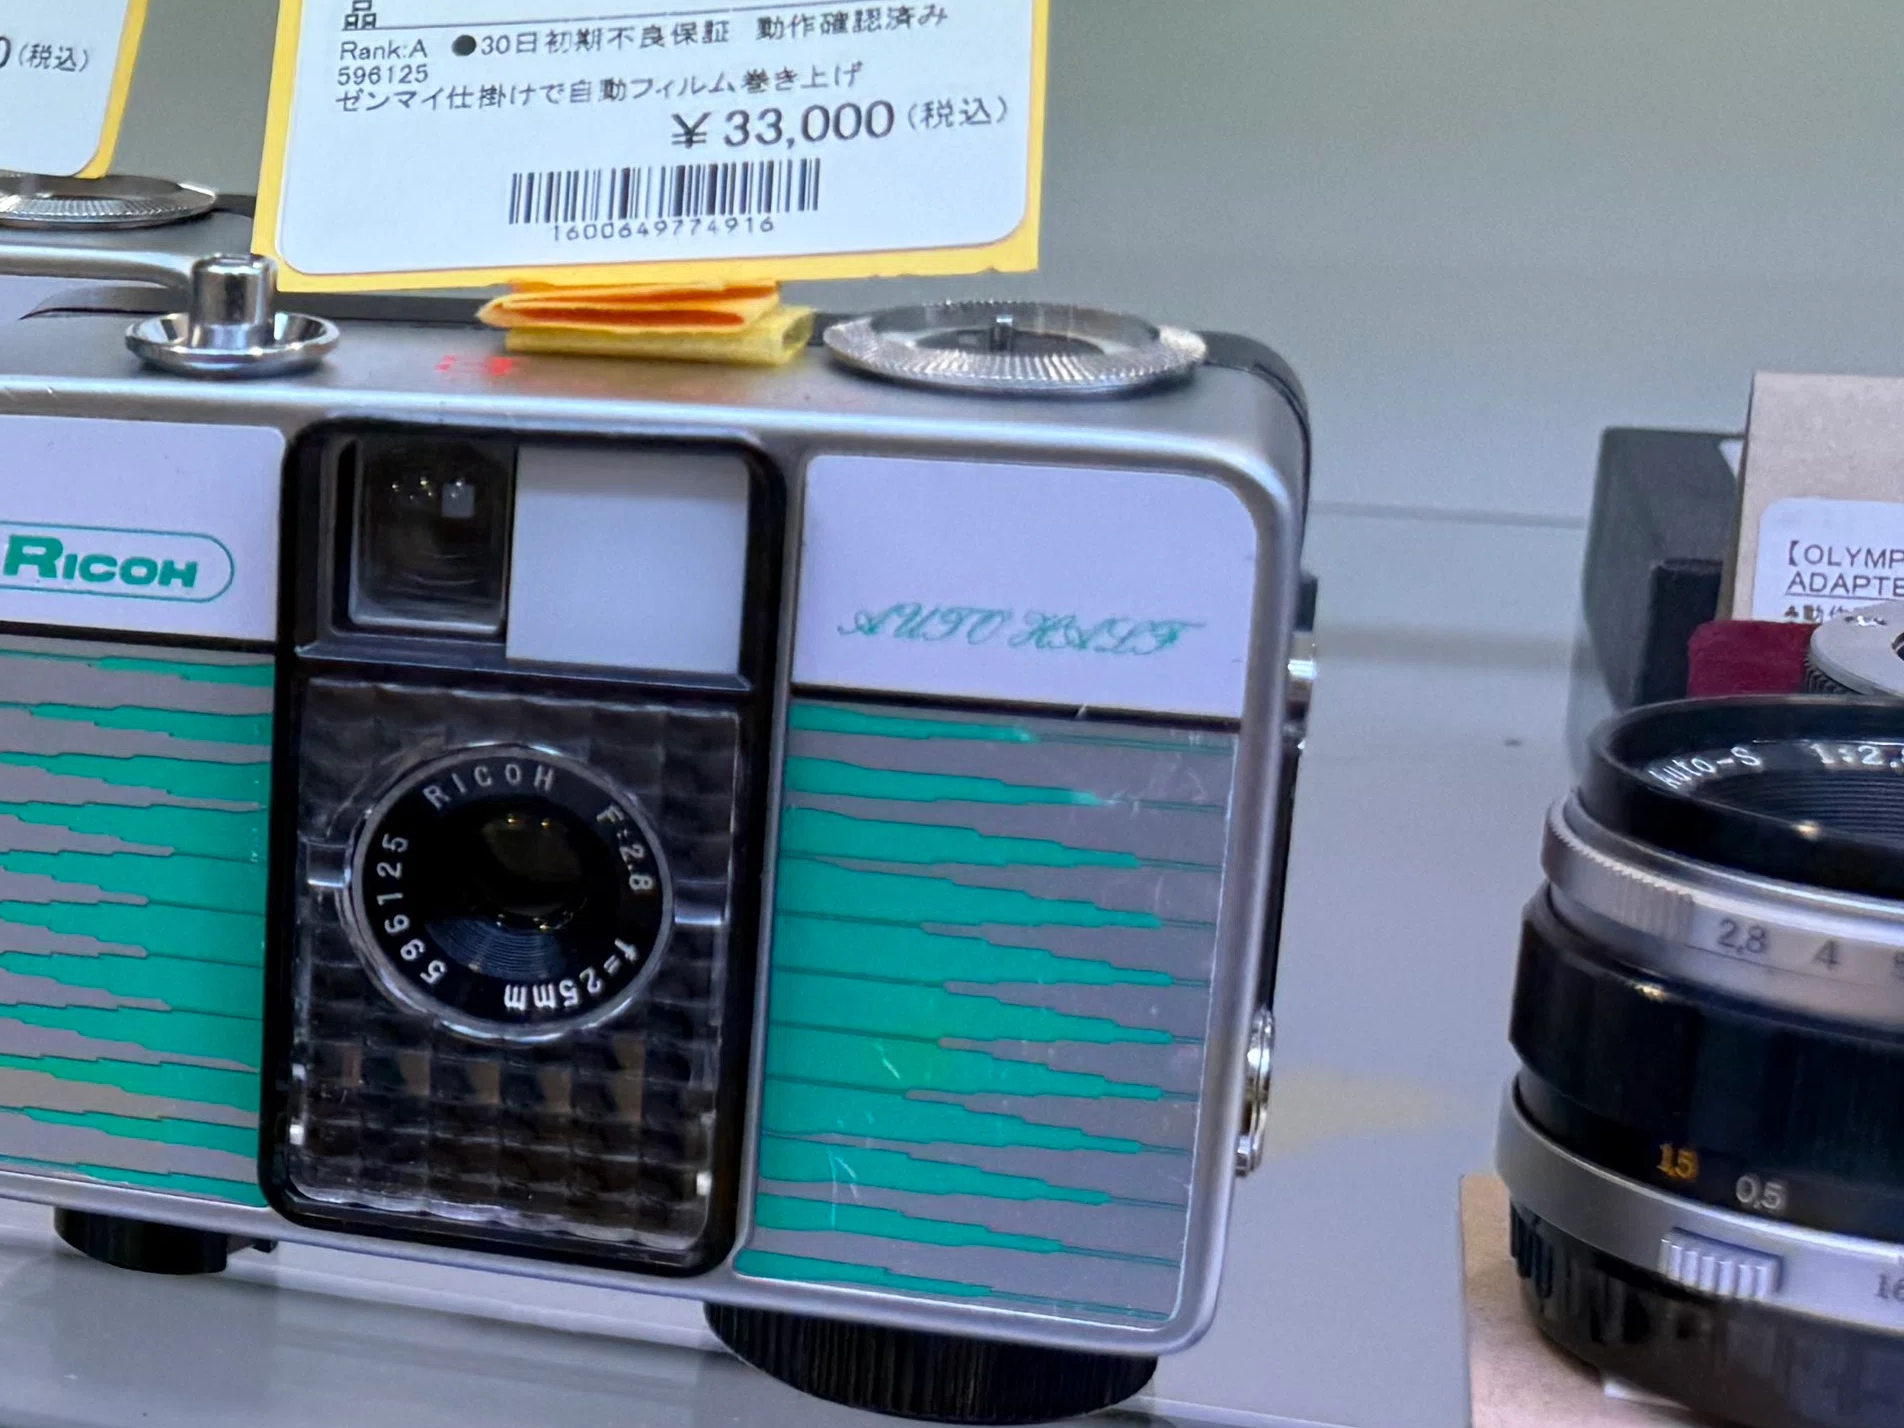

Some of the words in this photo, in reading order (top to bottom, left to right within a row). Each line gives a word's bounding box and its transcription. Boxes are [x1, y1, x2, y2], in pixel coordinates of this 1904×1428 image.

[340, 39, 427, 63] Rank:A
[756, 4, 949, 42] 動作確認済み
[338, 63, 429, 86] 596125
[670, 100, 895, 152] ¥33,000
[553, 217, 775, 243] 1600649774916
[3, 533, 198, 589] RICOH
[423, 763, 556, 810] RICOH
[1648, 745, 1762, 790] Auto-S
[377, 834, 448, 987] 596125
[1812, 940, 1840, 971] 4
